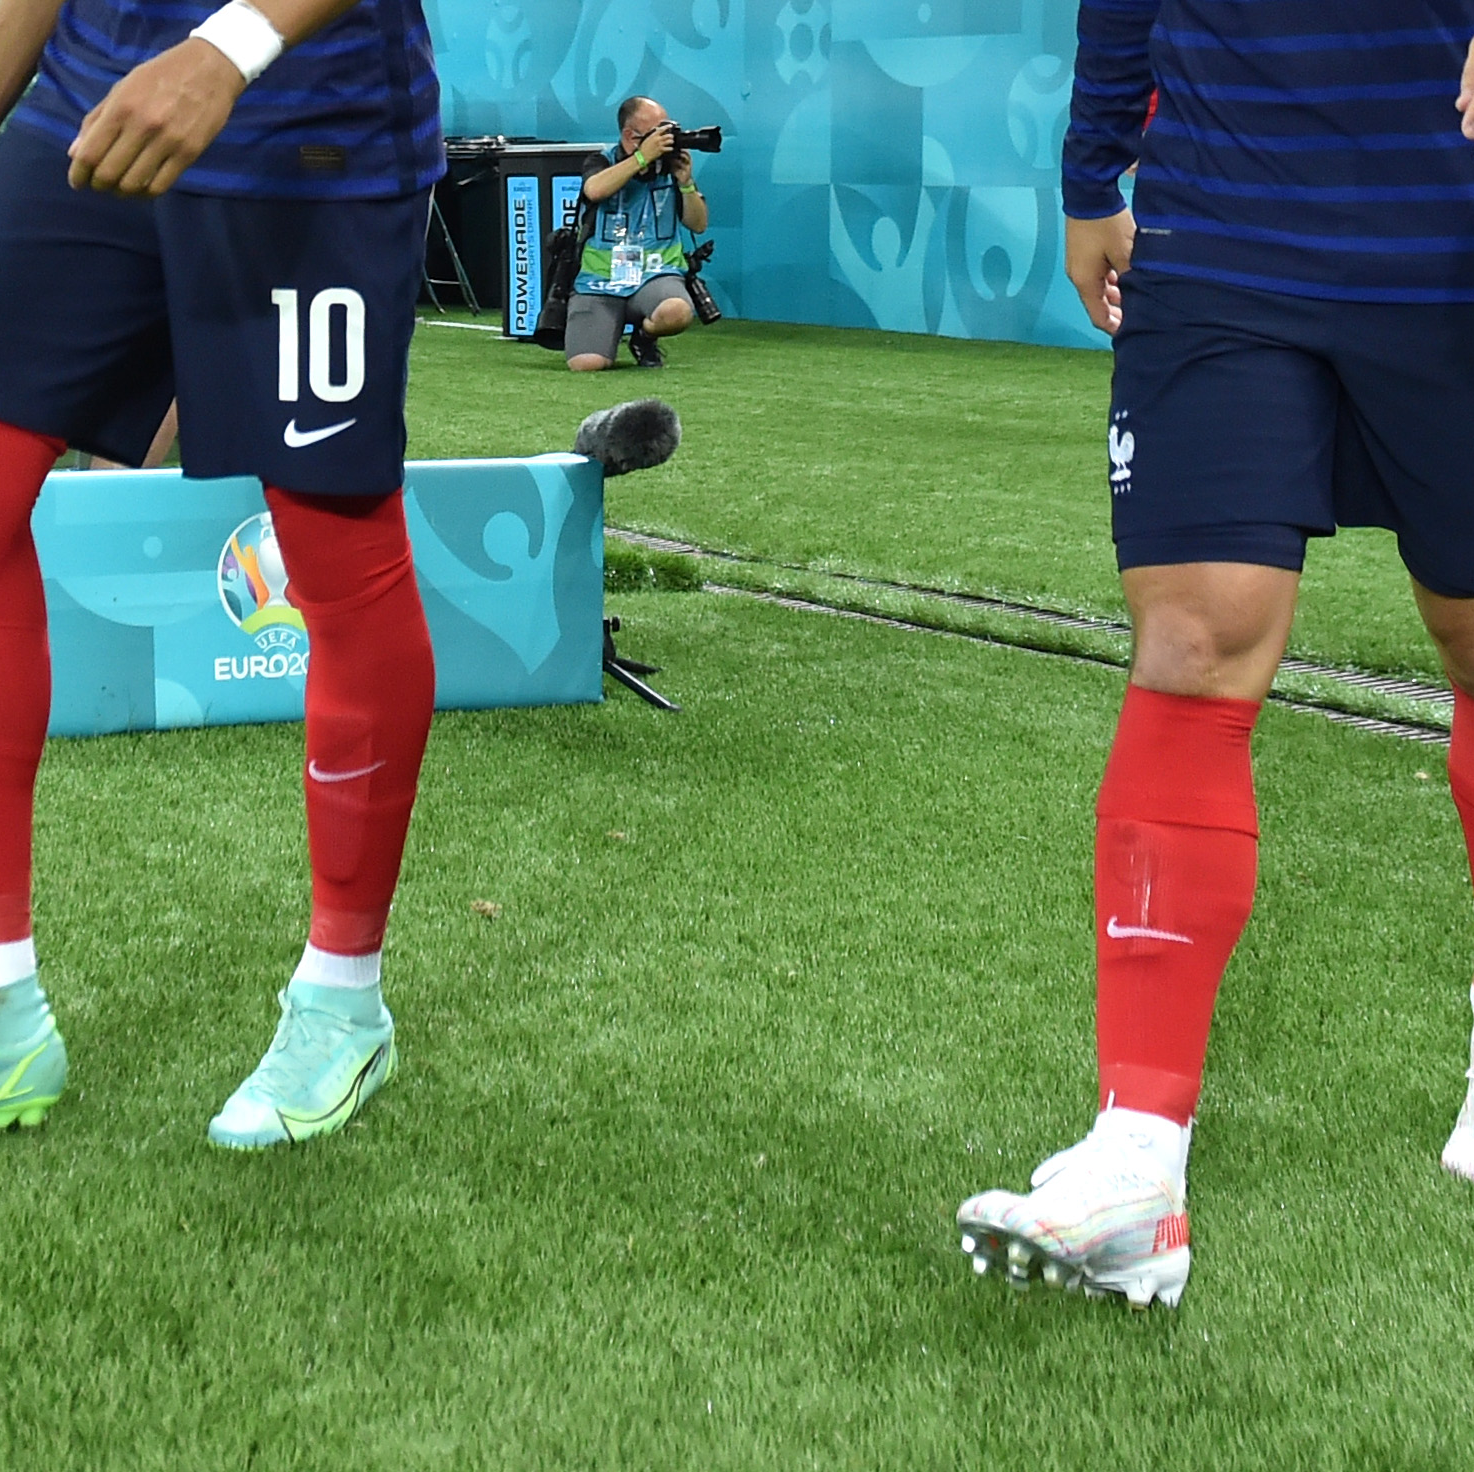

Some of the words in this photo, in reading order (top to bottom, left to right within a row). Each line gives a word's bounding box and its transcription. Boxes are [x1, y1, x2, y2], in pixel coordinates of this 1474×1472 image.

[513, 198, 529, 331] POWERADE
[271, 287, 366, 403] 10
[256, 631, 297, 649] UEFA
